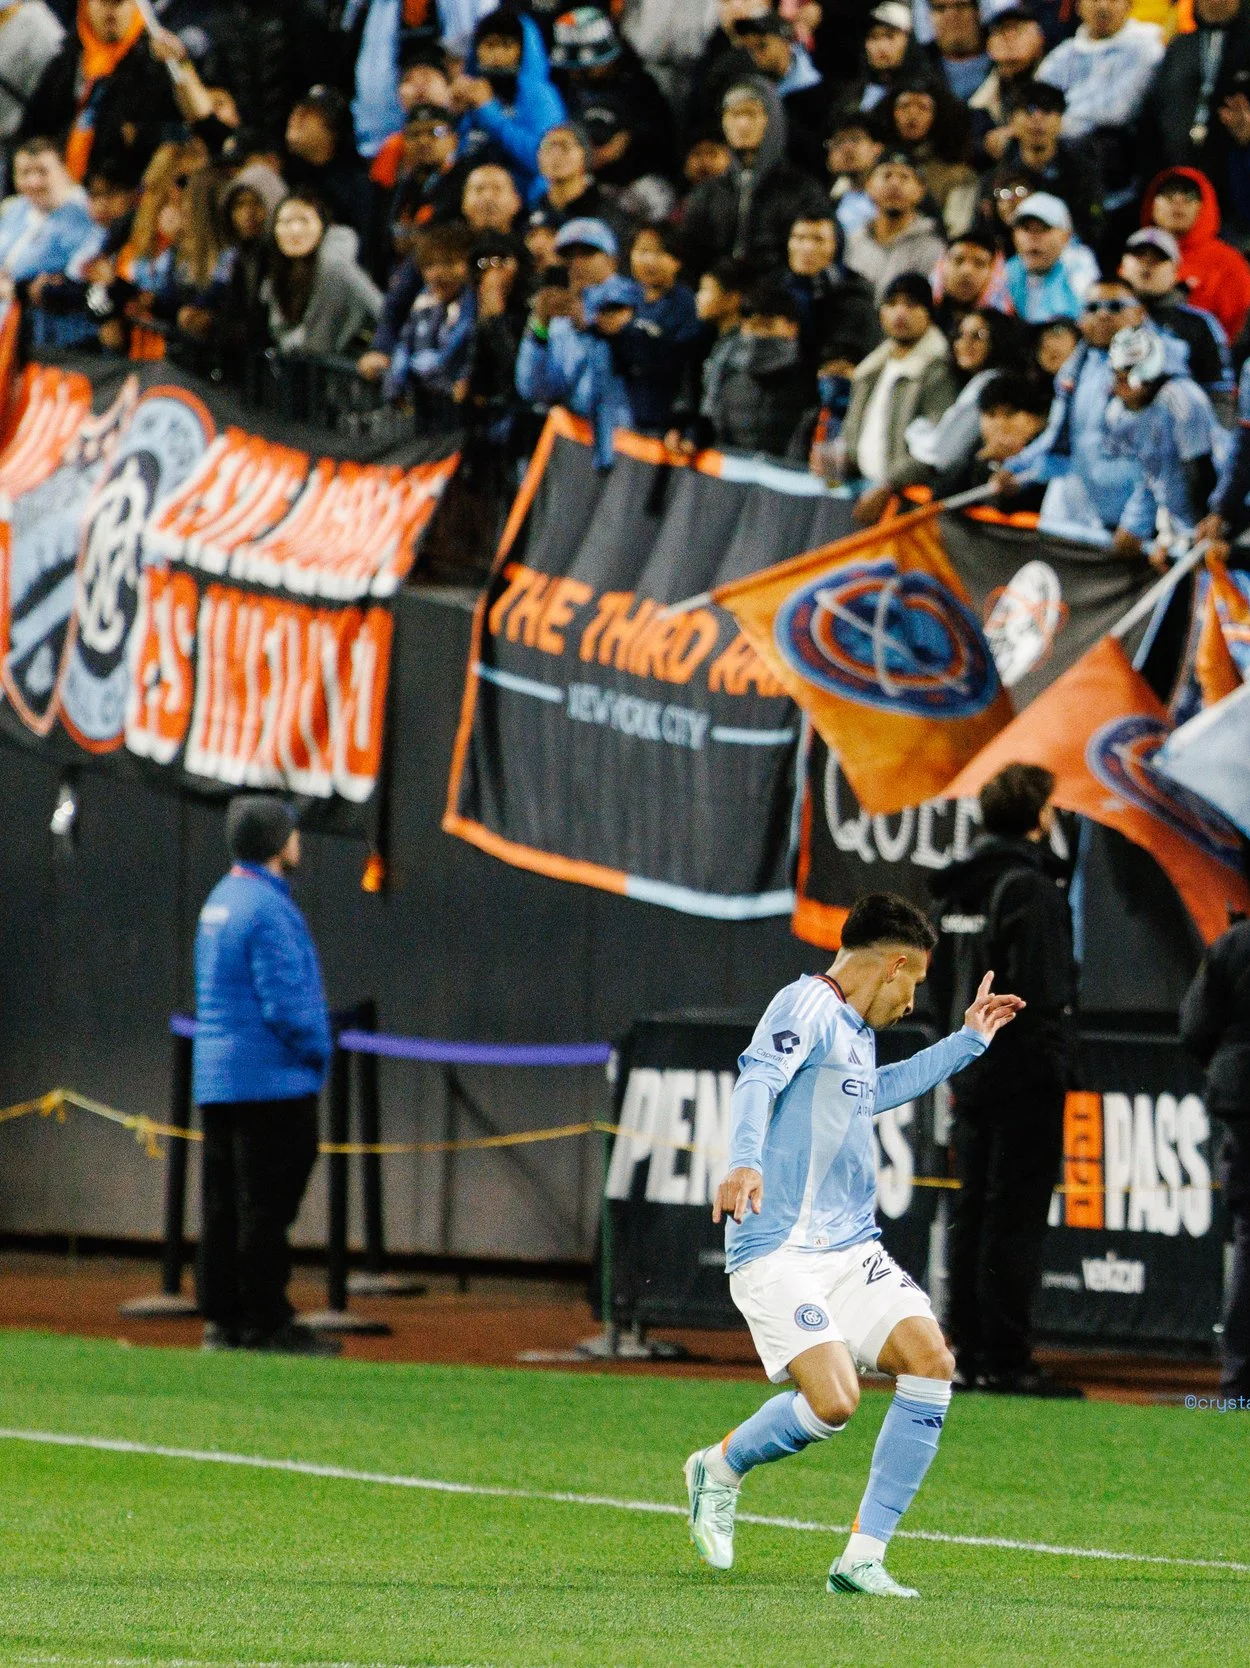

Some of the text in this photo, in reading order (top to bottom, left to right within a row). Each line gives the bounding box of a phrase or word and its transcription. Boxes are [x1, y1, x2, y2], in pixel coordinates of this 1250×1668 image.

[489, 562, 595, 656] THE
[578, 590, 720, 684] THIRD
[1102, 1091, 1213, 1238] PASS
